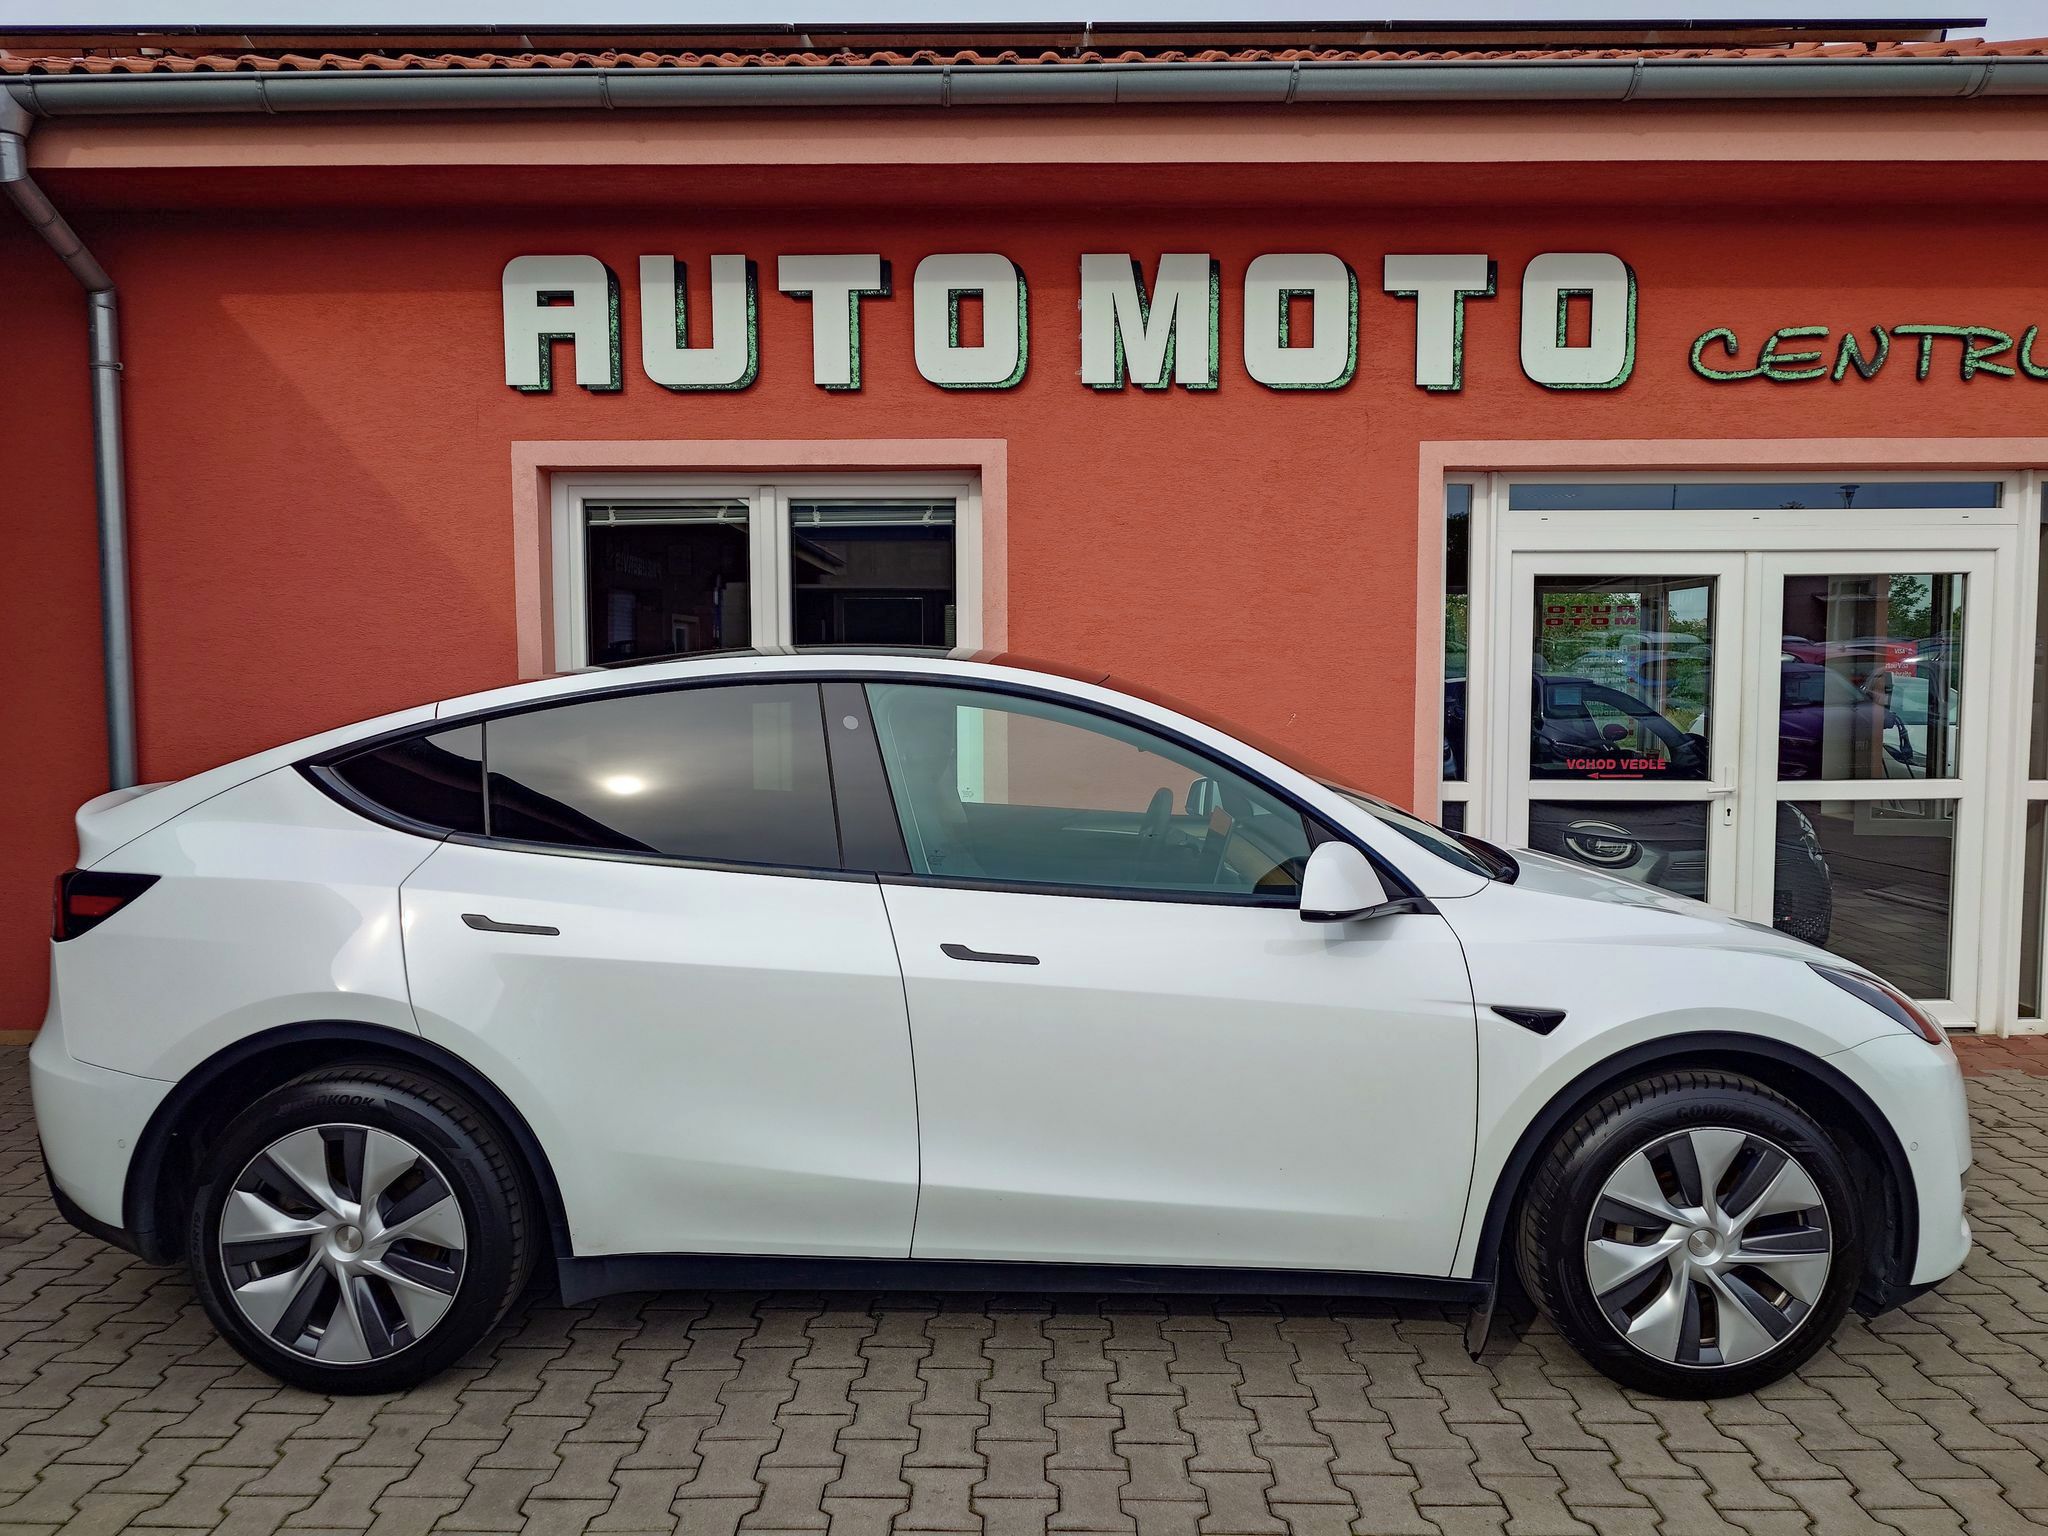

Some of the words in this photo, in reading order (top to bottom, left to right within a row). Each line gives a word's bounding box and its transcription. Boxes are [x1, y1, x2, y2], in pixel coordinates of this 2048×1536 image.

[502, 253, 1029, 391] AUTO
[1080, 252, 1638, 391] MOTO
[1566, 759, 1617, 770] VCHOD
[1620, 759, 1667, 770] VEDLE
